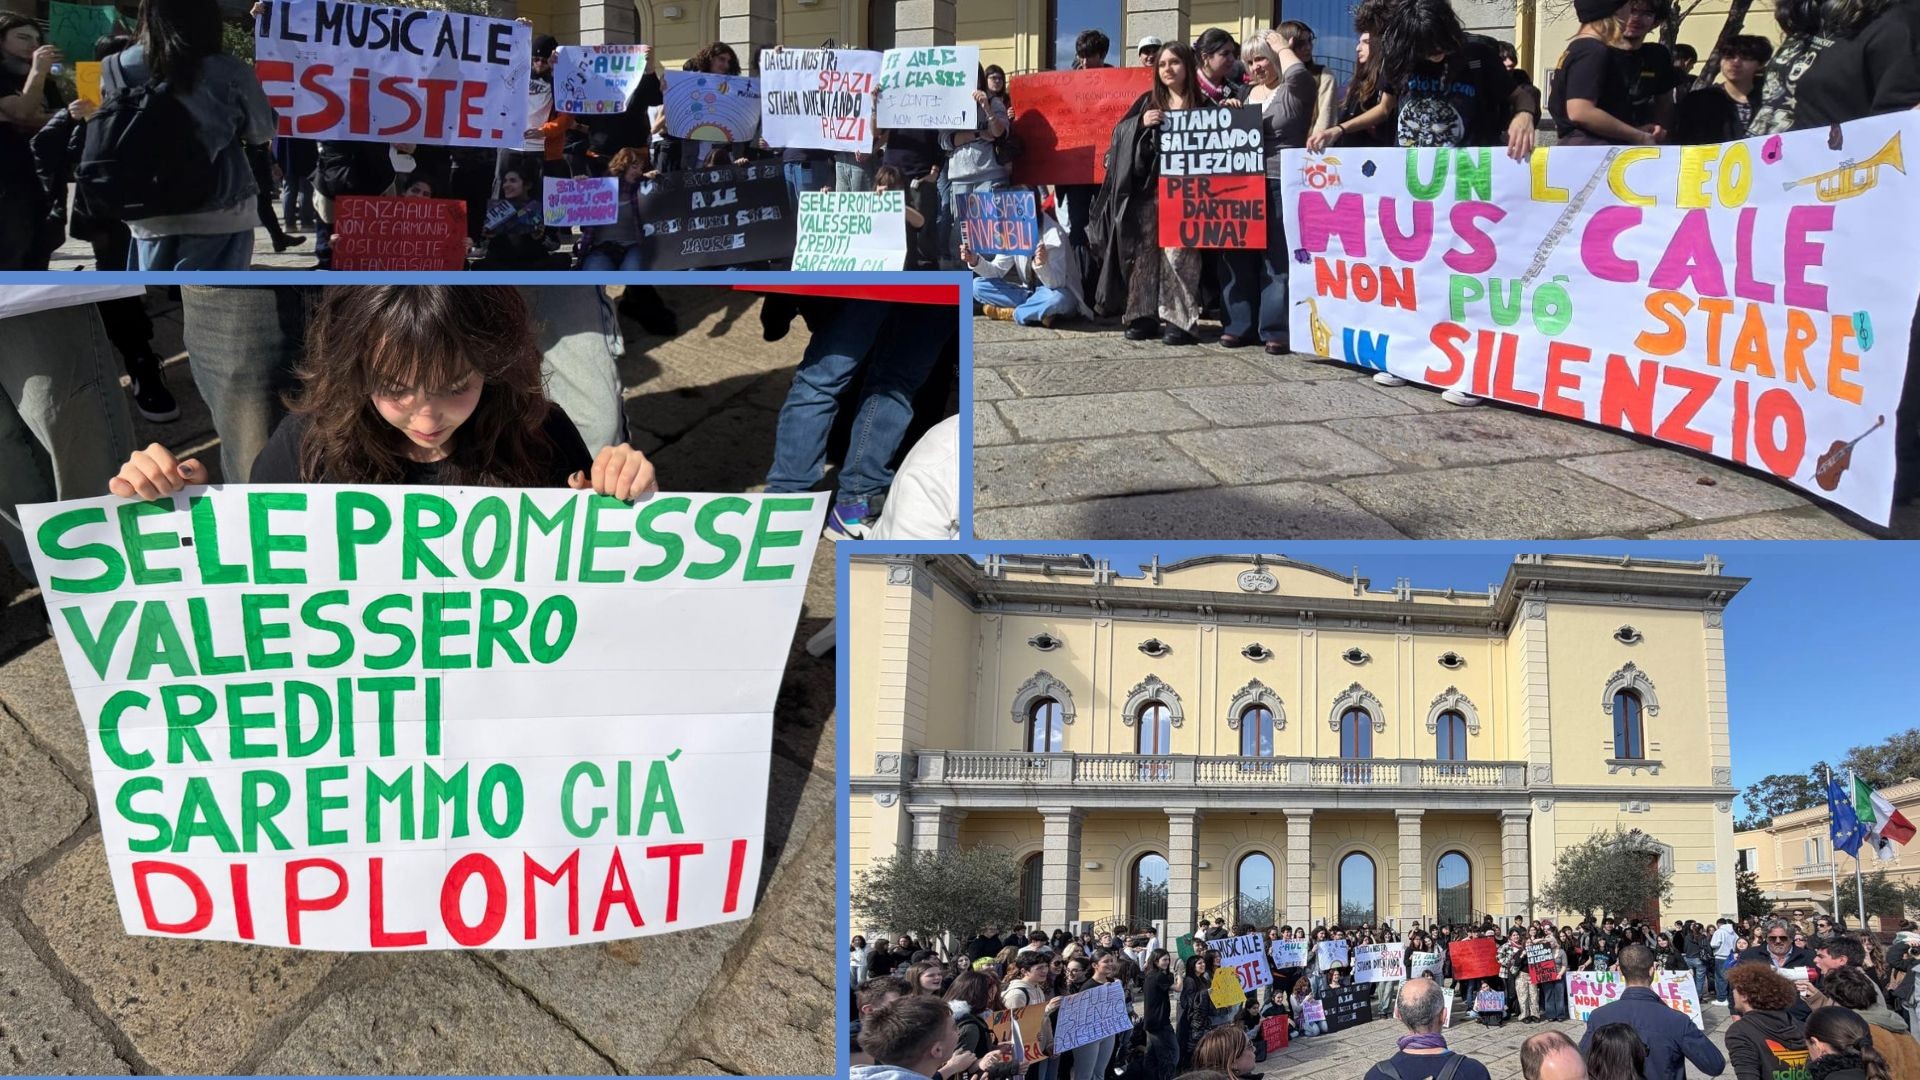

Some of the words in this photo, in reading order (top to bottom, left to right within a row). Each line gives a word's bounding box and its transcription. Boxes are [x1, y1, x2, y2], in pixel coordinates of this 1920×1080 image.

[259, 1, 308, 43] IL
[818, 70, 872, 94] SPAZI
[767, 91, 800, 116] STIAMO
[802, 90, 862, 118] DIVENTANDO
[821, 117, 866, 142] PAZZI
[1160, 128, 1261, 152] SALTANDO
[1160, 153, 1185, 175] LE
[1405, 147, 1492, 201] UN
[1166, 177, 1211, 199] PER
[341, 199, 405, 218] SENZA
[407, 202, 448, 219] AULE
[838, 192, 903, 213] PROMESSE
[991, 192, 1036, 219] SIAMO
[1183, 199, 1265, 220] DARTENE
[336, 219, 365, 234] NON
[799, 214, 872, 235] VALESSERO
[966, 219, 1033, 250] INVISIBILI
[1179, 221, 1248, 247] UNA!
[797, 234, 851, 255] CREDITI
[794, 254, 857, 271] SAREMMO
[1314, 257, 1417, 312] NON
[1634, 290, 1864, 406] STARE
[1342, 327, 1389, 373] IN
[1423, 322, 1807, 480] SILENZIO
[336, 491, 815, 583] PROMESSE
[60, 588, 578, 681] VALESSERO
[98, 676, 441, 770] CREDITI
[115, 762, 525, 853] SAREMMO
[131, 839, 748, 948] DIPLOMATI
[1575, 995, 1599, 1007] NON
